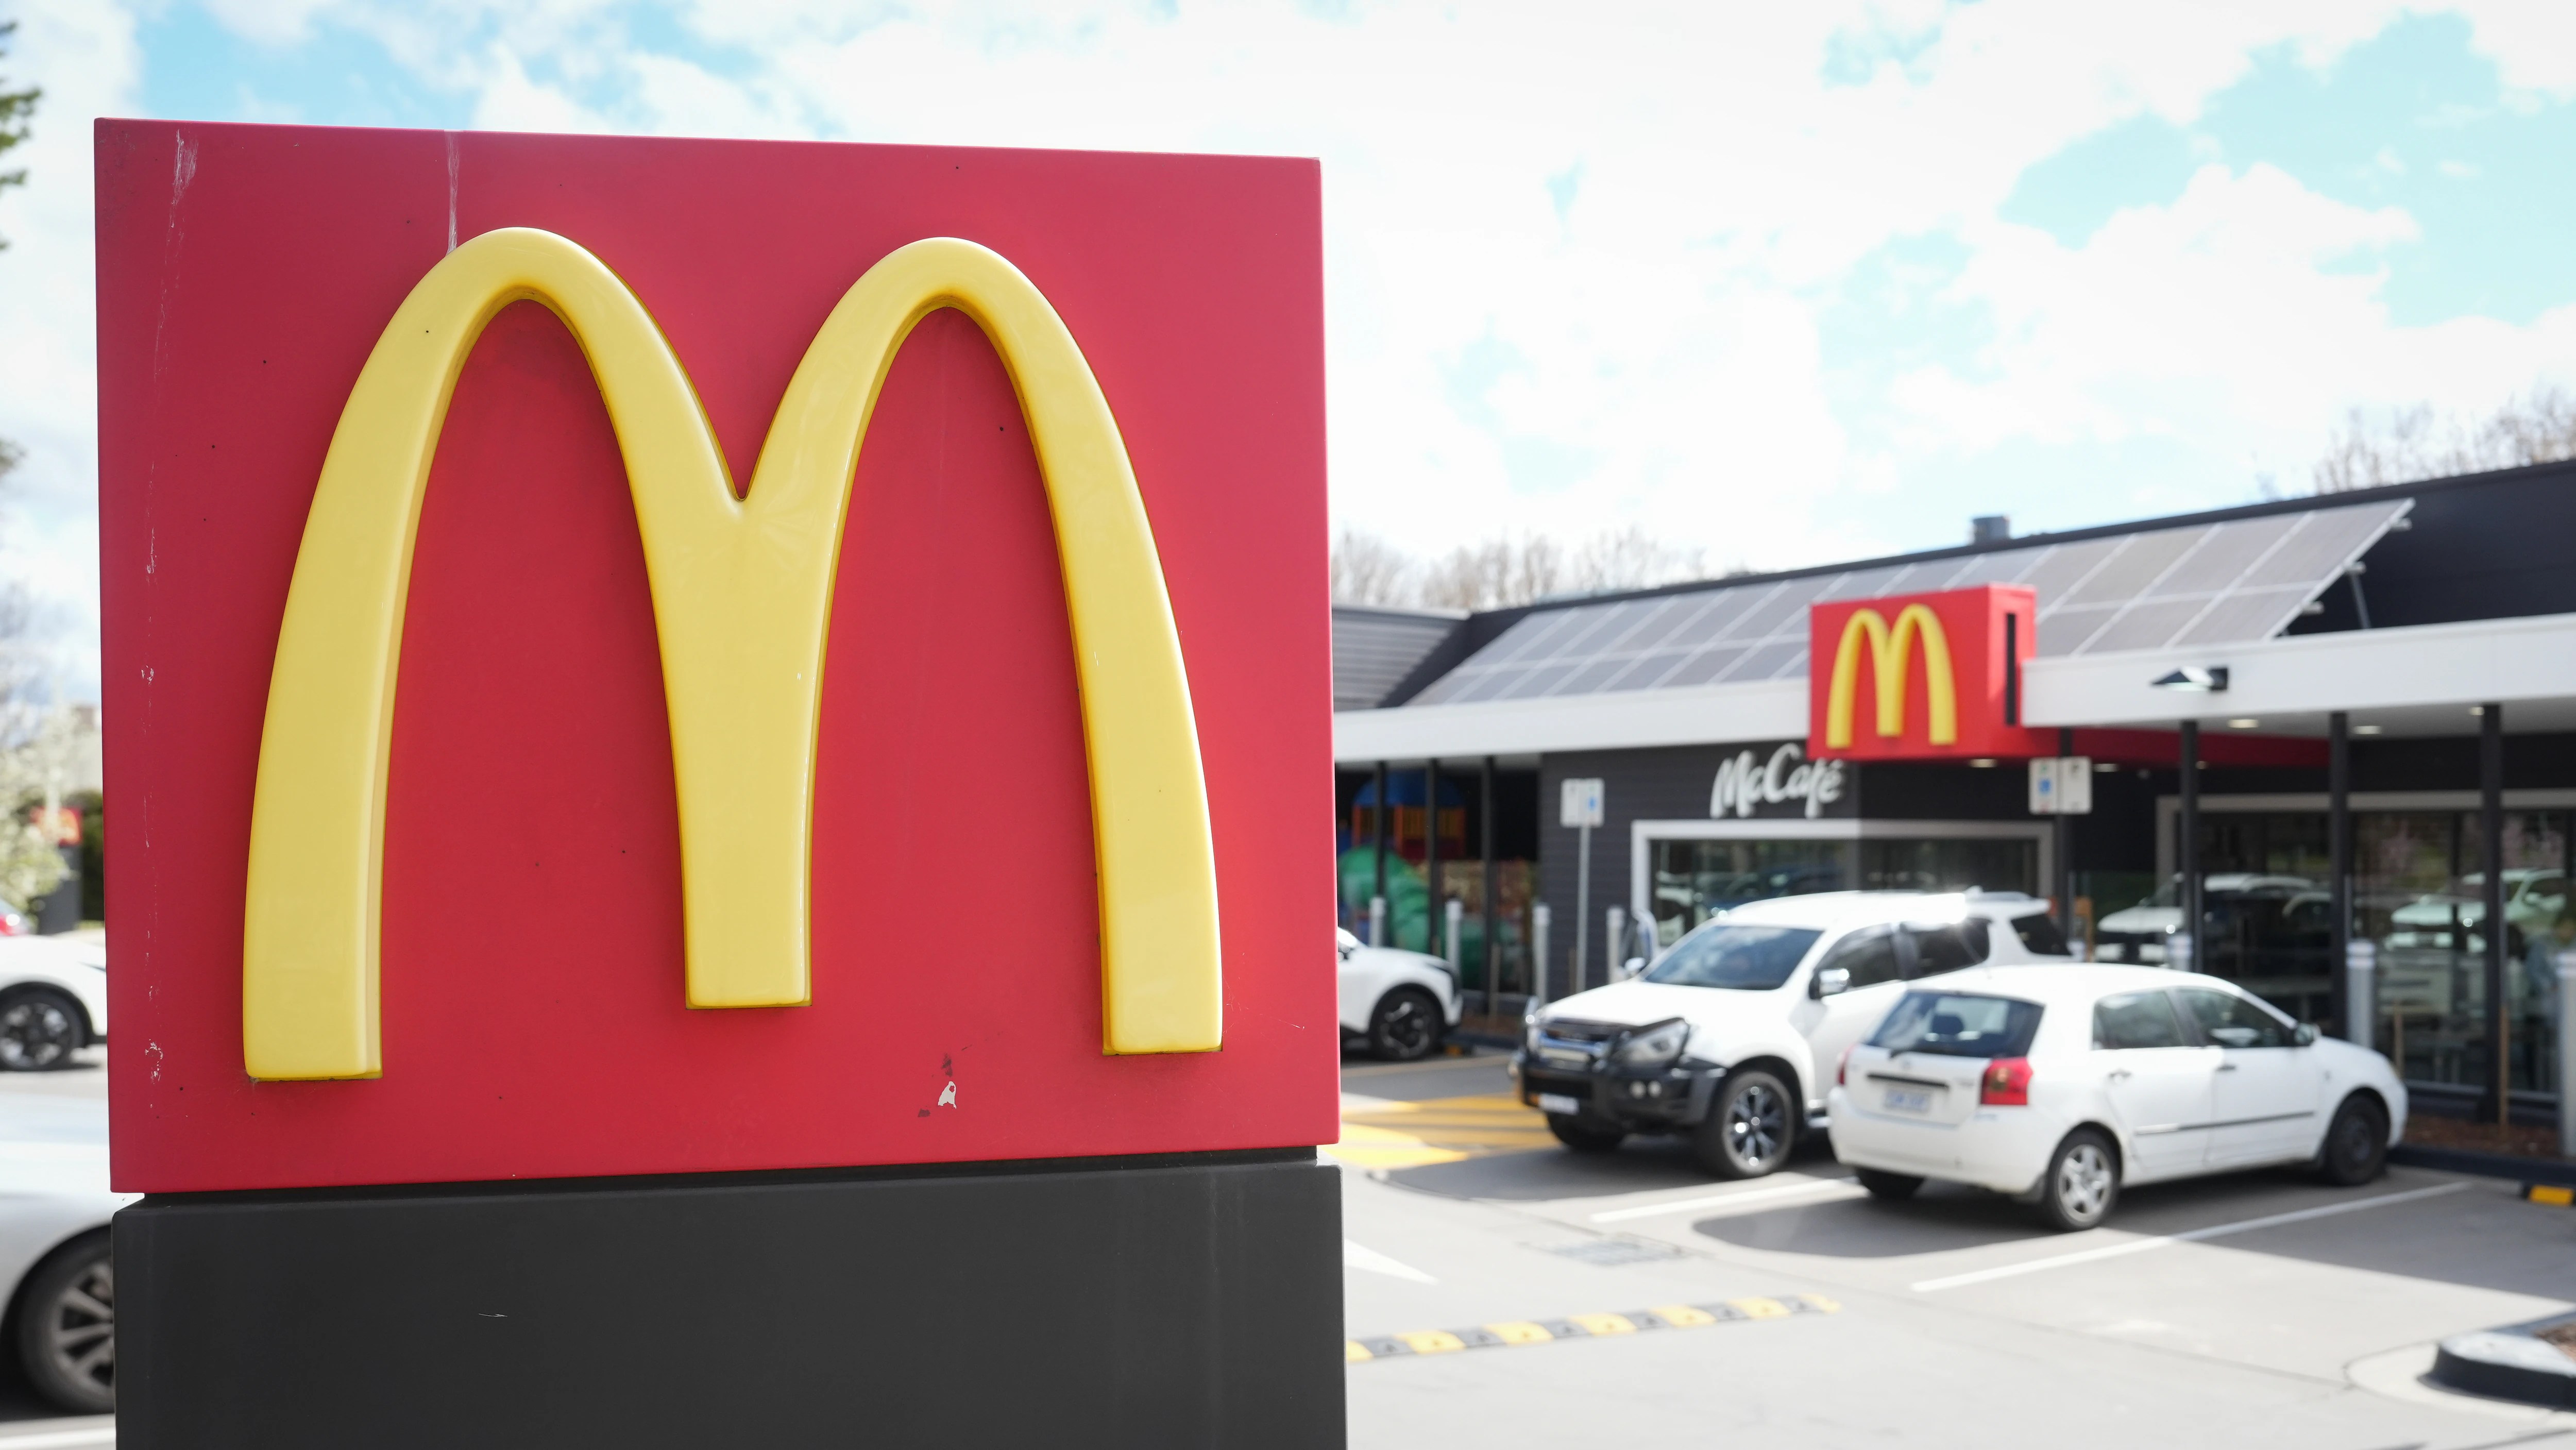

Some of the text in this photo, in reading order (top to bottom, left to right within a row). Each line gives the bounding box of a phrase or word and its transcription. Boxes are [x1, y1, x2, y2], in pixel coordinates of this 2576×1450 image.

[243, 227, 1223, 1080] M
[1826, 603, 1956, 748] M
[1710, 742, 1844, 818] McCafé
